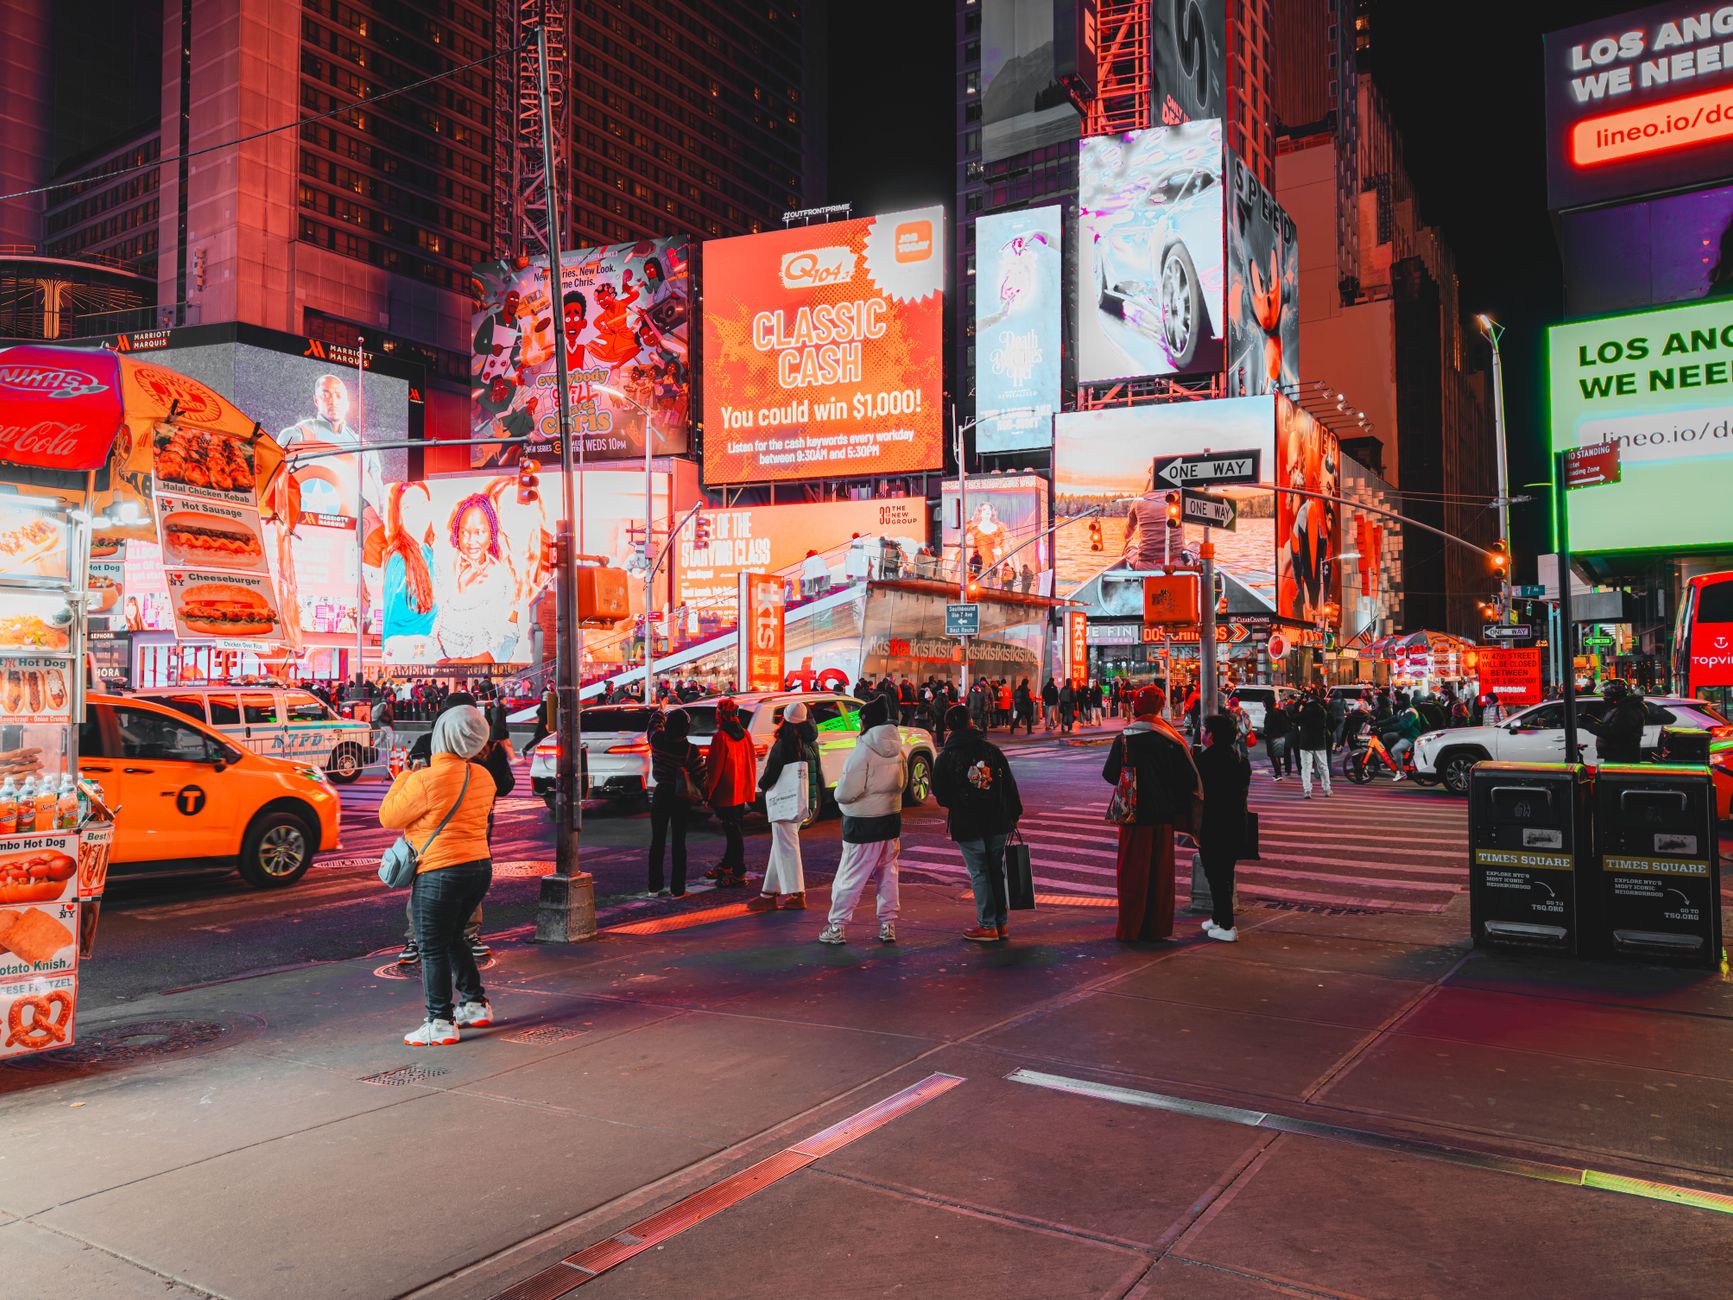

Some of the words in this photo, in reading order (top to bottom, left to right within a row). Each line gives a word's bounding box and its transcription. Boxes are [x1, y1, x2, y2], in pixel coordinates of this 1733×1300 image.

[1572, 31, 1644, 71] LOS
[1572, 66, 1632, 102] WE
[1235, 158, 1292, 247] SPEED
[562, 270, 578, 278] ries.
[580, 266, 594, 275] New
[596, 264, 616, 274] Look.
[574, 278, 596, 288] Chris.
[753, 298, 887, 351] CLASSIC
[134, 330, 171, 340] MARRIOTT
[134, 340, 167, 348] MARQUIS
[1578, 337, 1649, 367] LOS
[330, 352, 368, 366] MARQUS
[778, 343, 862, 389] CASH
[1579, 372, 1638, 400] WE
[1649, 360, 1733, 392] NEE
[721, 406, 753, 429] You
[758, 400, 808, 426] could
[814, 397, 848, 421] win
[853, 389, 922, 421] $1,000!
[537, 444, 552, 452] SERIES
[586, 438, 606, 452] WEDS
[609, 438, 627, 450] 10PM
[728, 442, 754, 454] Listen
[755, 440, 768, 452] for
[769, 440, 783, 450] the
[784, 438, 804, 449] cash
[806, 434, 848, 448] keywords
[850, 432, 874, 444] every
[876, 429, 915, 442] workday
[759, 452, 796, 464] between
[829, 448, 846, 460] and
[1576, 446, 1610, 458] STANDING
[1169, 464, 1198, 479] ONE
[1213, 460, 1246, 476] WAY
[162, 482, 186, 492] Halal
[188, 487, 223, 498] Chicken
[225, 493, 250, 503] Kebab
[182, 502, 200, 510] Hot
[202, 504, 242, 518] Sausage
[1190, 501, 1207, 516] ONE
[1214, 505, 1230, 520] WAY
[735, 538, 771, 565] CLASS
[188, 573, 261, 586] Cheeseburger
[758, 580, 778, 650] tkts
[1074, 616, 1084, 662] tkts
[1108, 626, 1132, 637] FIN
[18, 658, 40, 667] Hot
[44, 659, 66, 669] Dog
[1691, 652, 1733, 669] Topvi
[272, 734, 323, 748] NYPD
[24, 840, 42, 848] Hot
[46, 838, 66, 848] Dog
[87, 832, 107, 841] Best
[1478, 852, 1518, 864] TIMES
[1521, 856, 1570, 867] SQUARE
[1606, 860, 1648, 870] TIMES
[1652, 862, 1706, 873] SQUARE
[59, 910, 76, 918] NY
[34, 958, 66, 972] Knish
